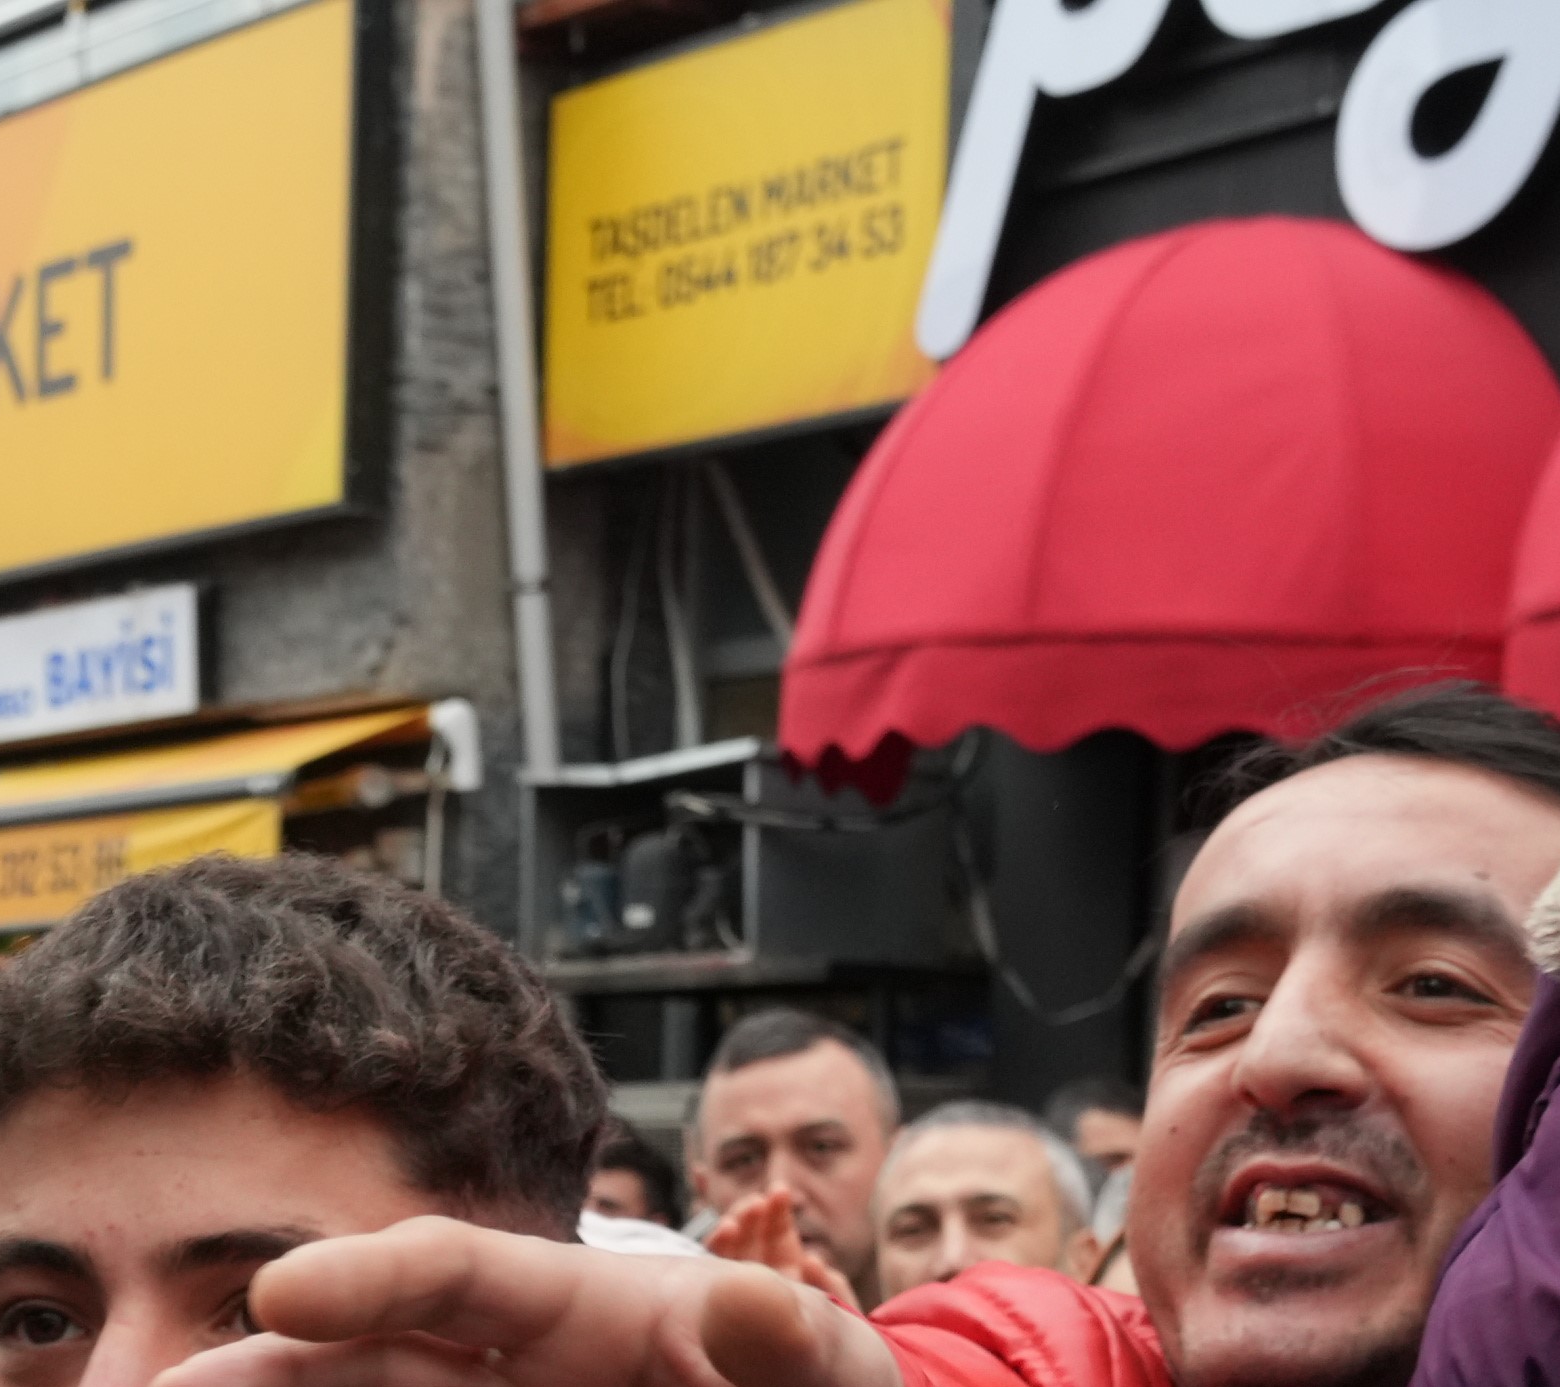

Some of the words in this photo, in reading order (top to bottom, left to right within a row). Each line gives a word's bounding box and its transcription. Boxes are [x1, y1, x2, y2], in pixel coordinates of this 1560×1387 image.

[761, 137, 906, 218] MARKET
[658, 254, 738, 308] 0544
[747, 231, 801, 284] 187
[808, 219, 851, 272] 34
[860, 205, 905, 260] 53
[45, 611, 176, 706] BAYİSİ
